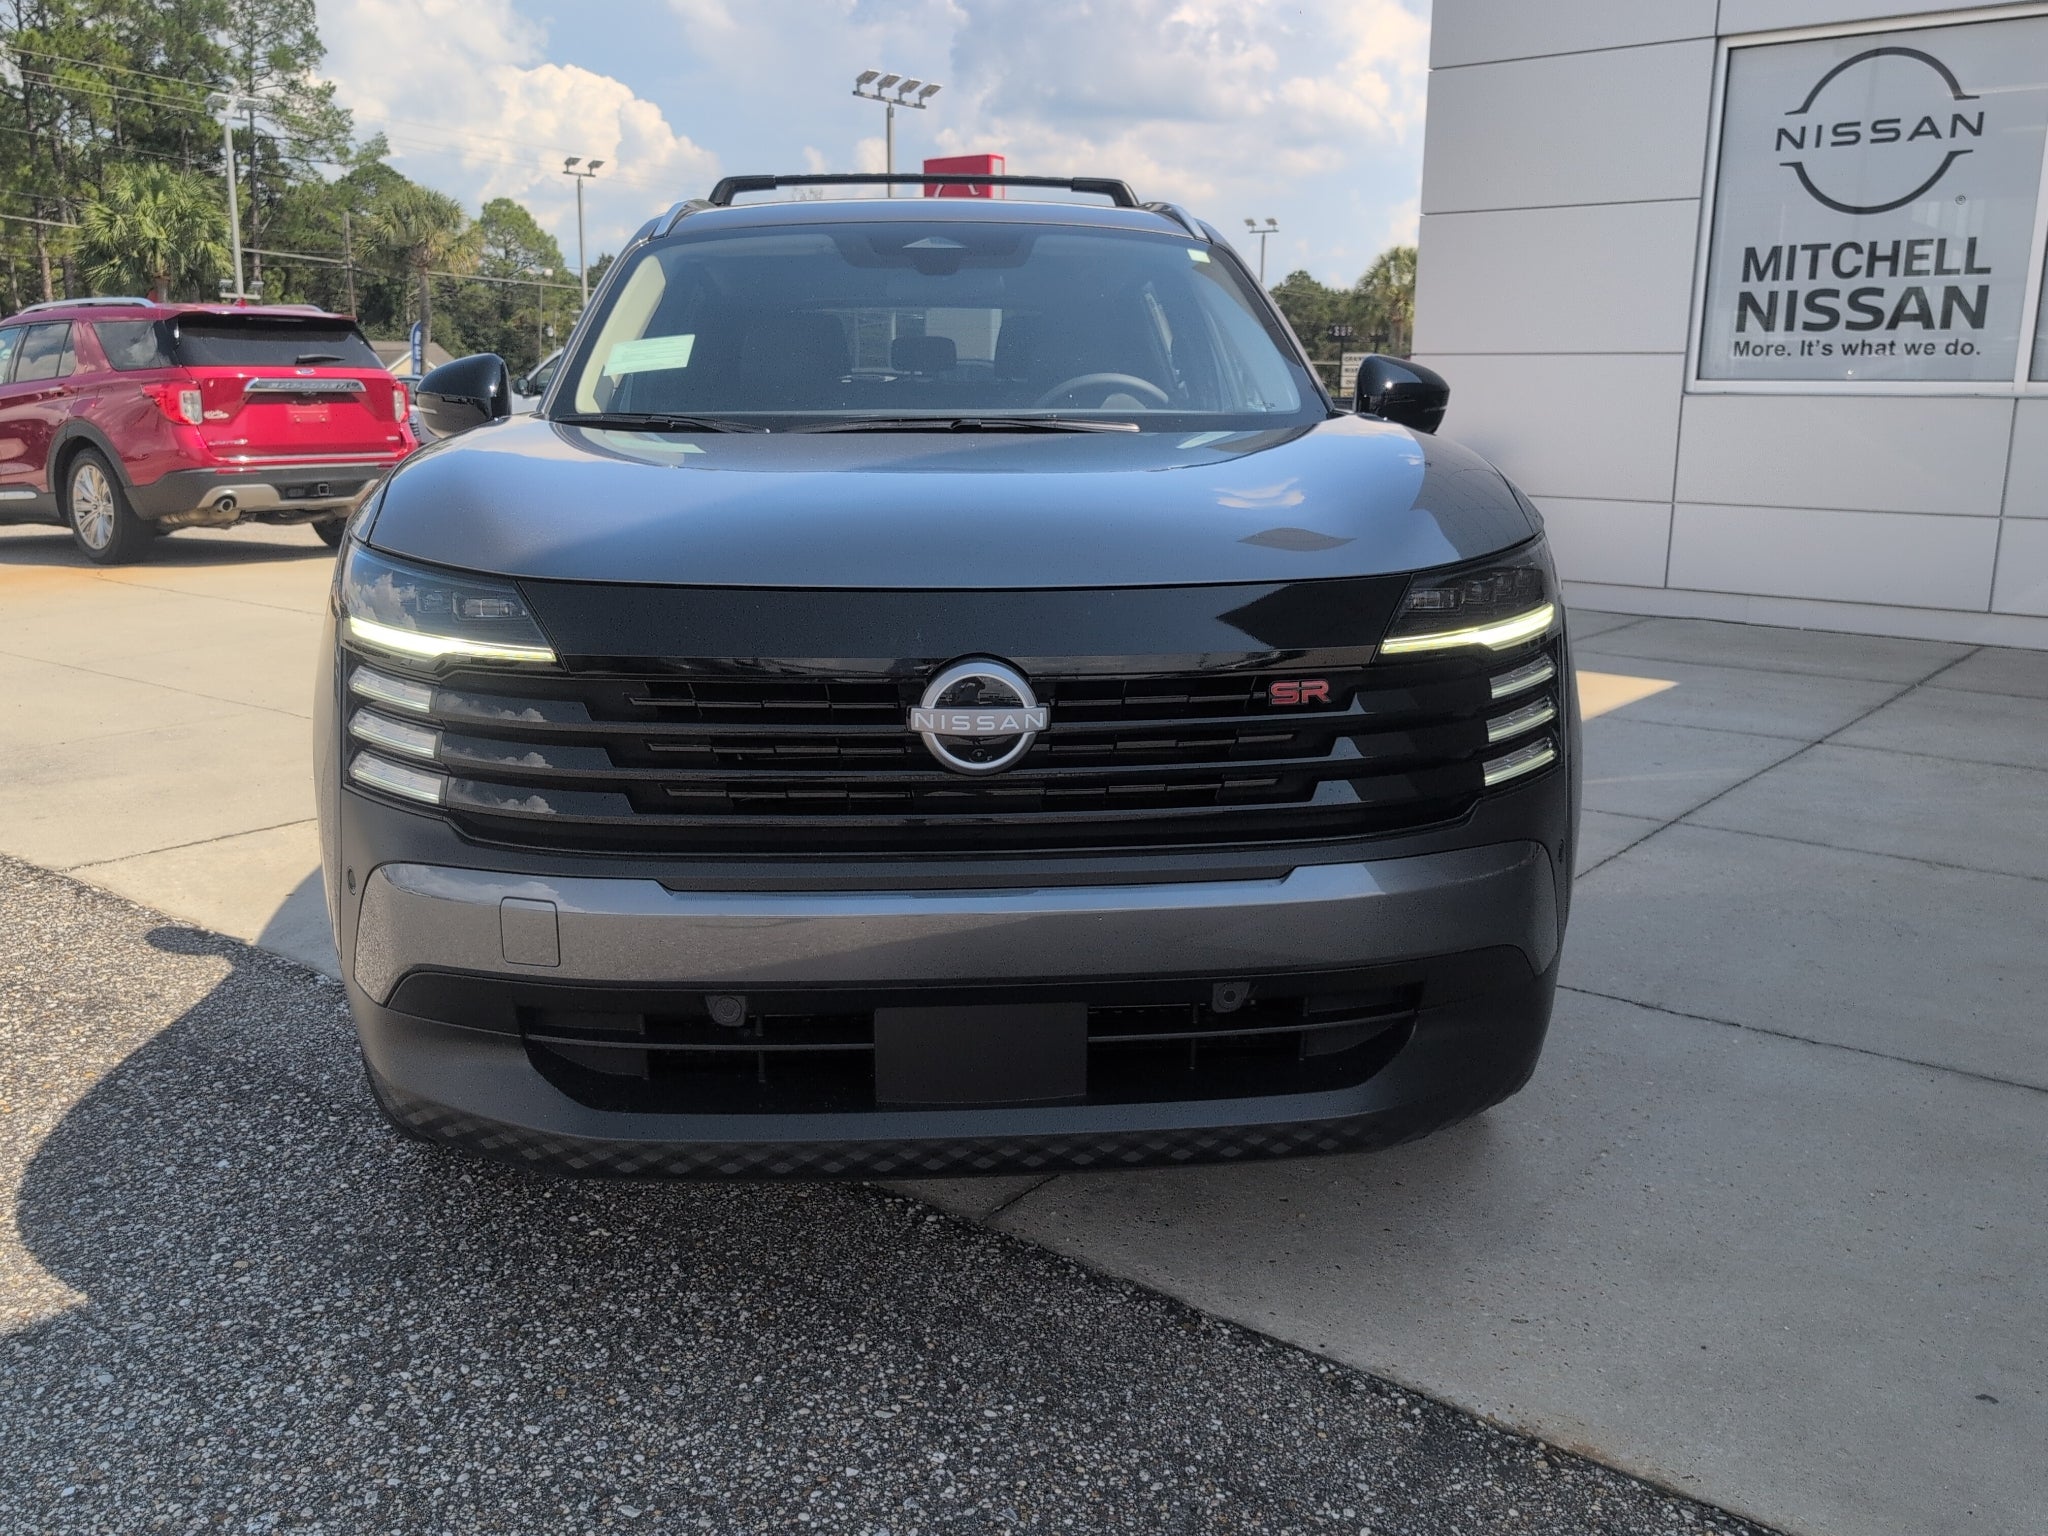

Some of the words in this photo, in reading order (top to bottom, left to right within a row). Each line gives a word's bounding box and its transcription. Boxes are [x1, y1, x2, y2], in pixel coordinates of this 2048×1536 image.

[1774, 111, 1985, 151] NISSAN
[1741, 236, 1992, 283] MITCHELL
[1735, 284, 1990, 333] NISSAN
[1733, 340, 1792, 357] More.
[1800, 339, 1833, 357] It's
[1840, 339, 1896, 357] what
[1904, 341, 1936, 356] we
[1944, 338, 1981, 356] do.
[1270, 680, 1331, 705] SR
[914, 712, 1044, 731] NISSAN
